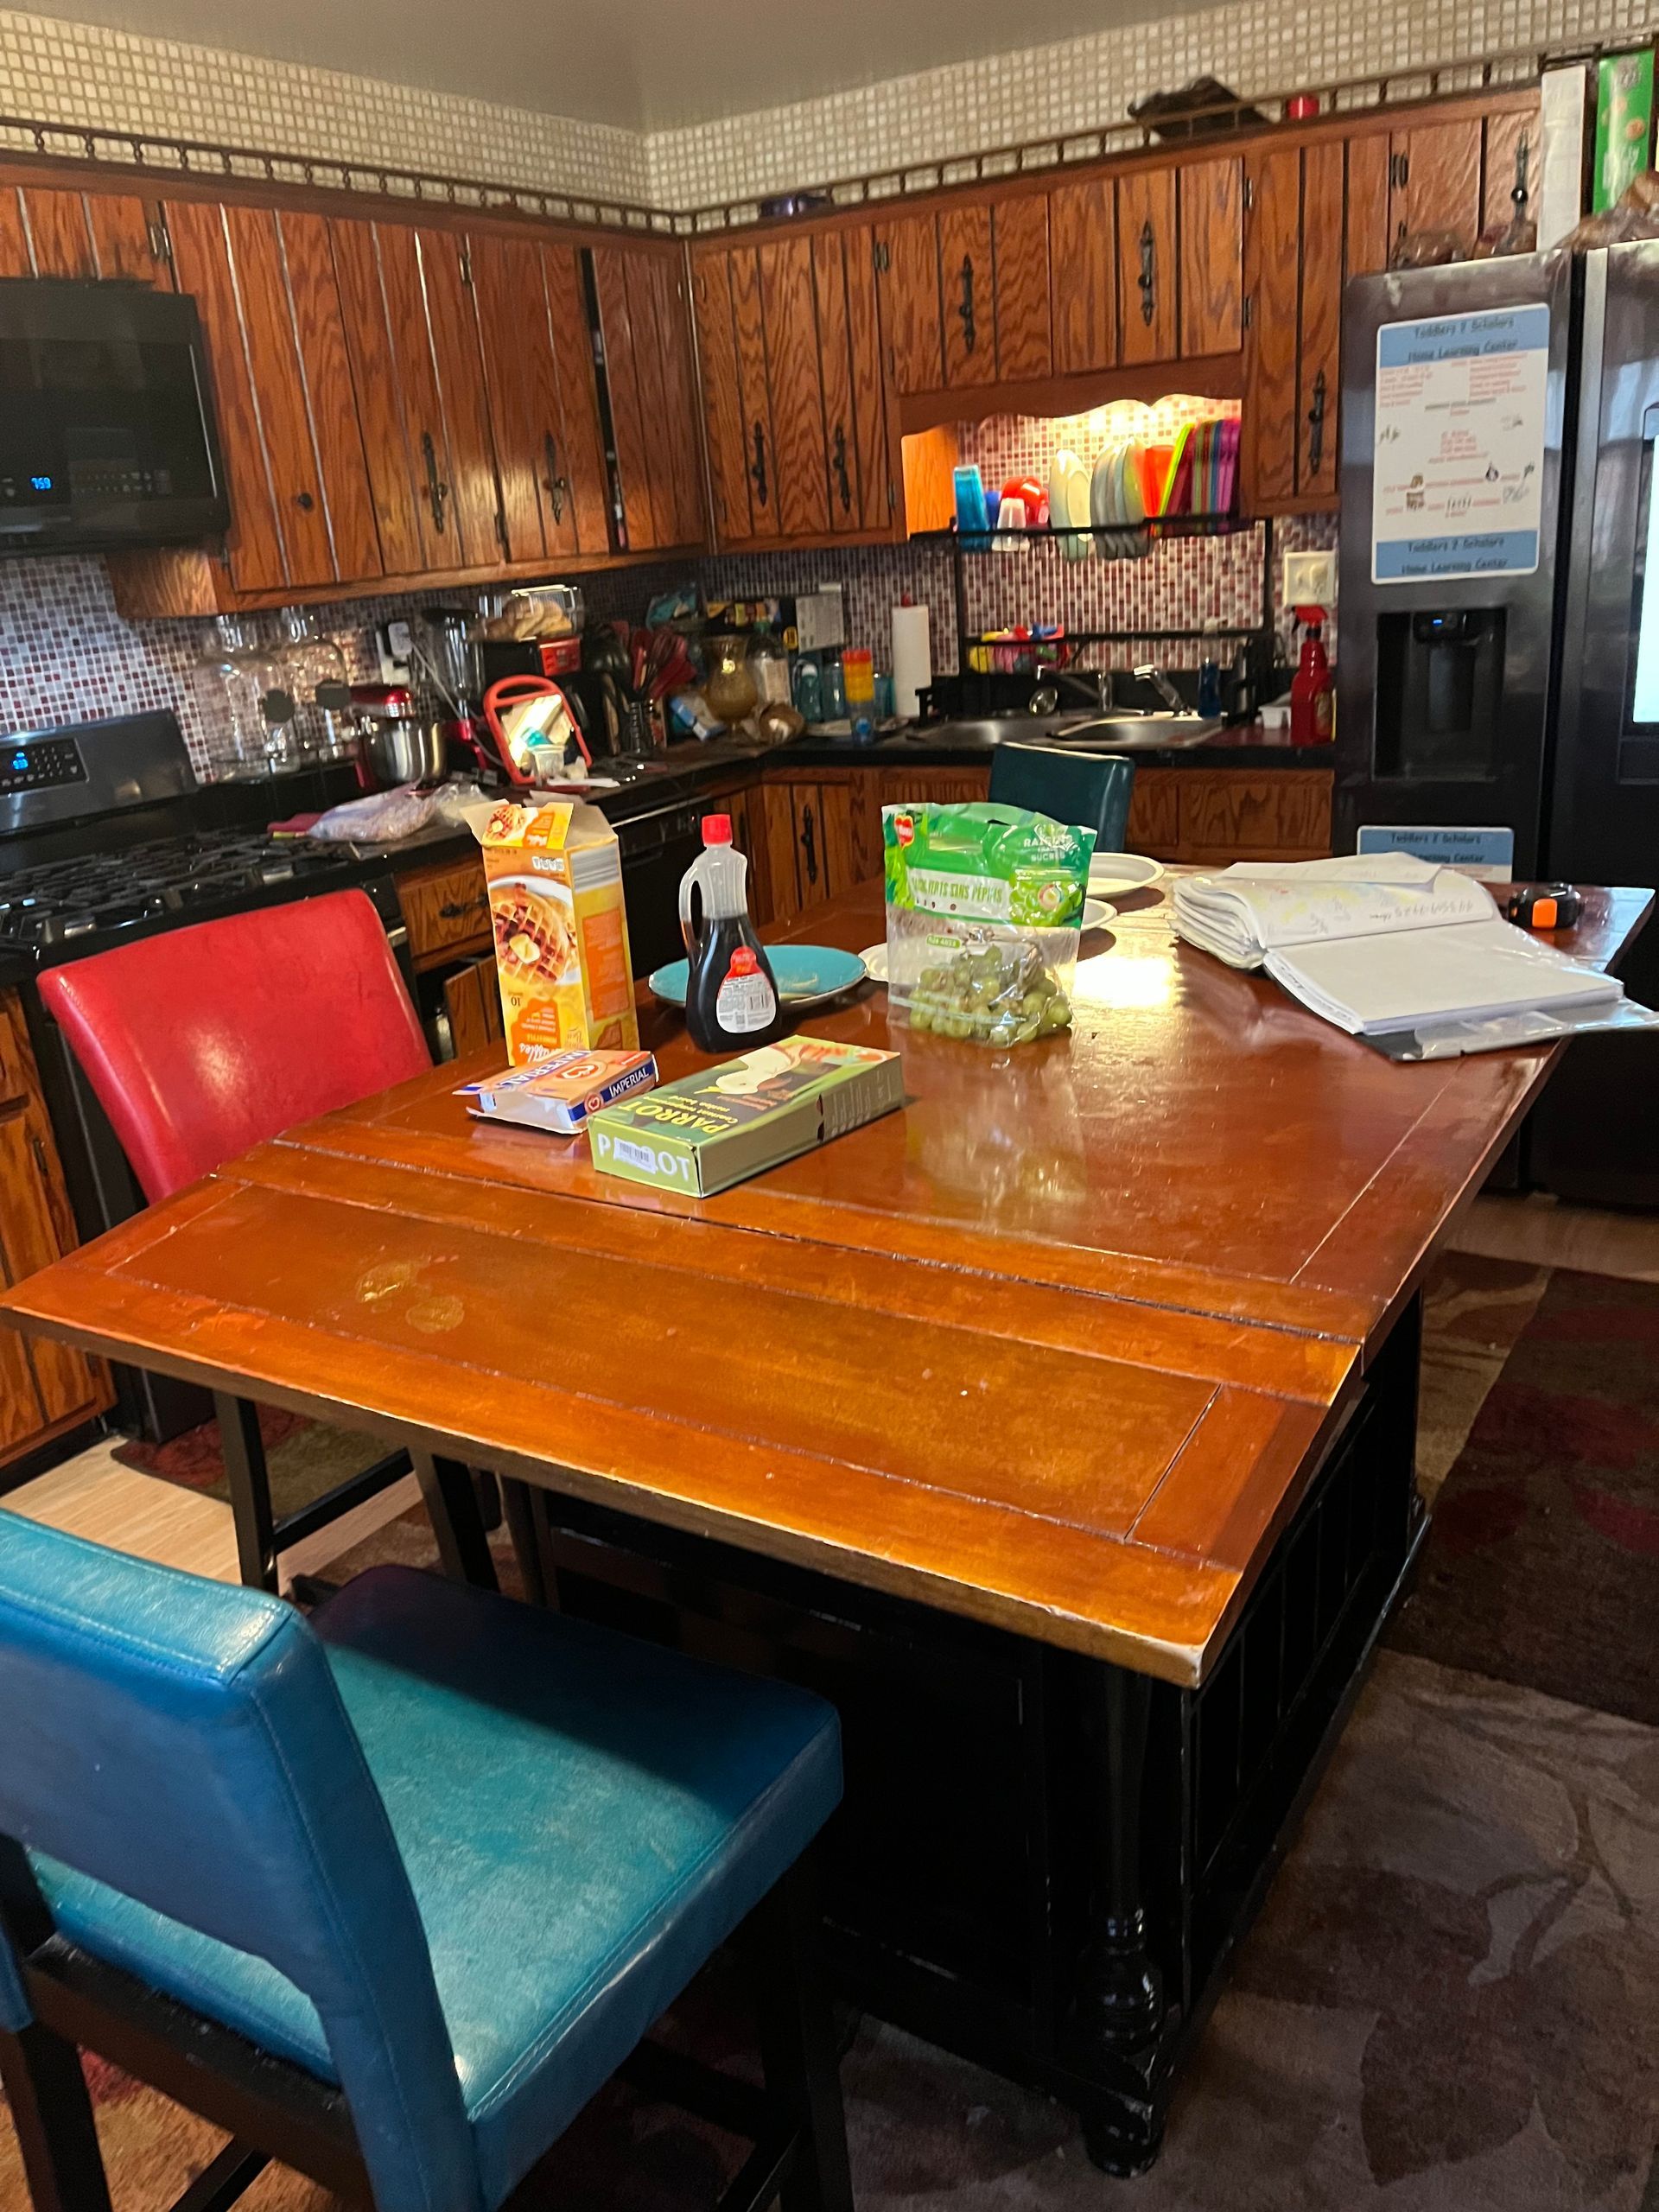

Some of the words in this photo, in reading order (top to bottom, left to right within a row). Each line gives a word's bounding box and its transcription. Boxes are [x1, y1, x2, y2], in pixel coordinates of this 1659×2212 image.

[1476, 557, 1509, 569] Center
[511, 996, 521, 1007] 10
[608, 1067, 650, 1097] IMPERIAL
[618, 1101, 731, 1135] PARROT
